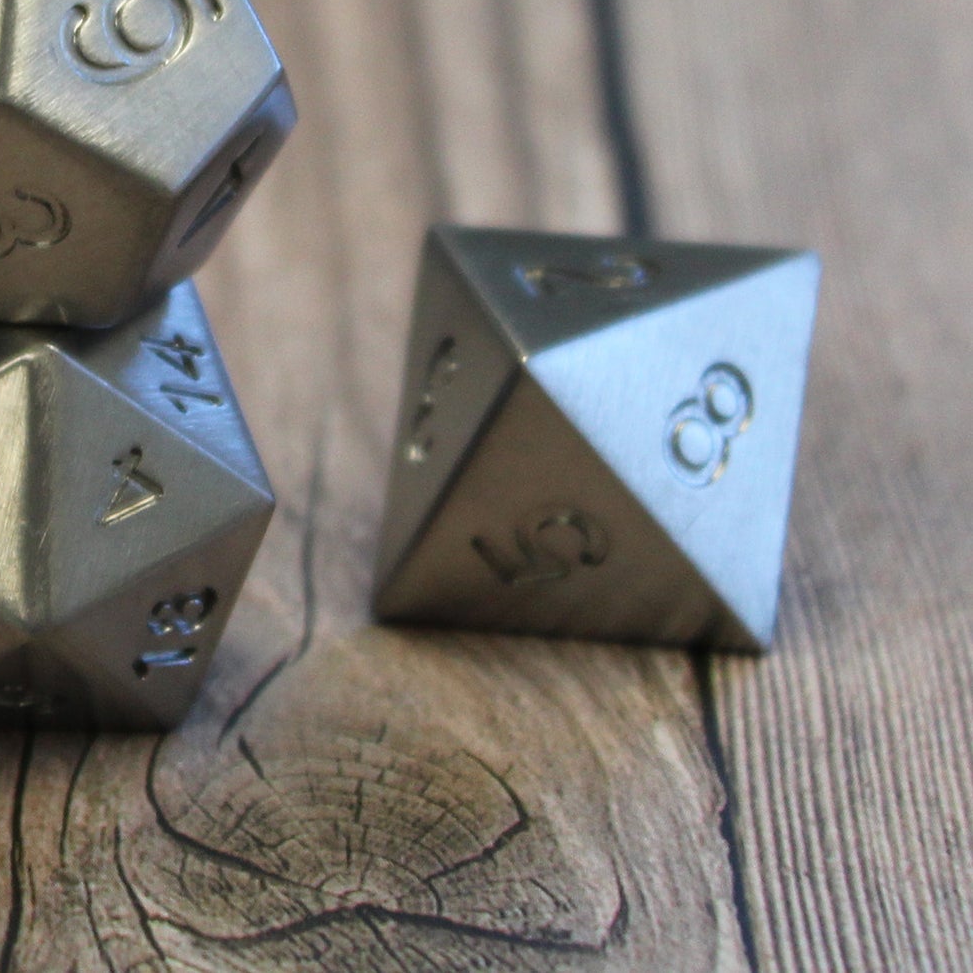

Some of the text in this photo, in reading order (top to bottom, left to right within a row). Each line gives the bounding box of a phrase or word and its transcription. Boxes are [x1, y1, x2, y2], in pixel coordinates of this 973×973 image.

[140, 334, 224, 414] 14
[662, 361, 755, 489] 8
[96, 444, 165, 526] 4
[470, 501, 610, 587] 5
